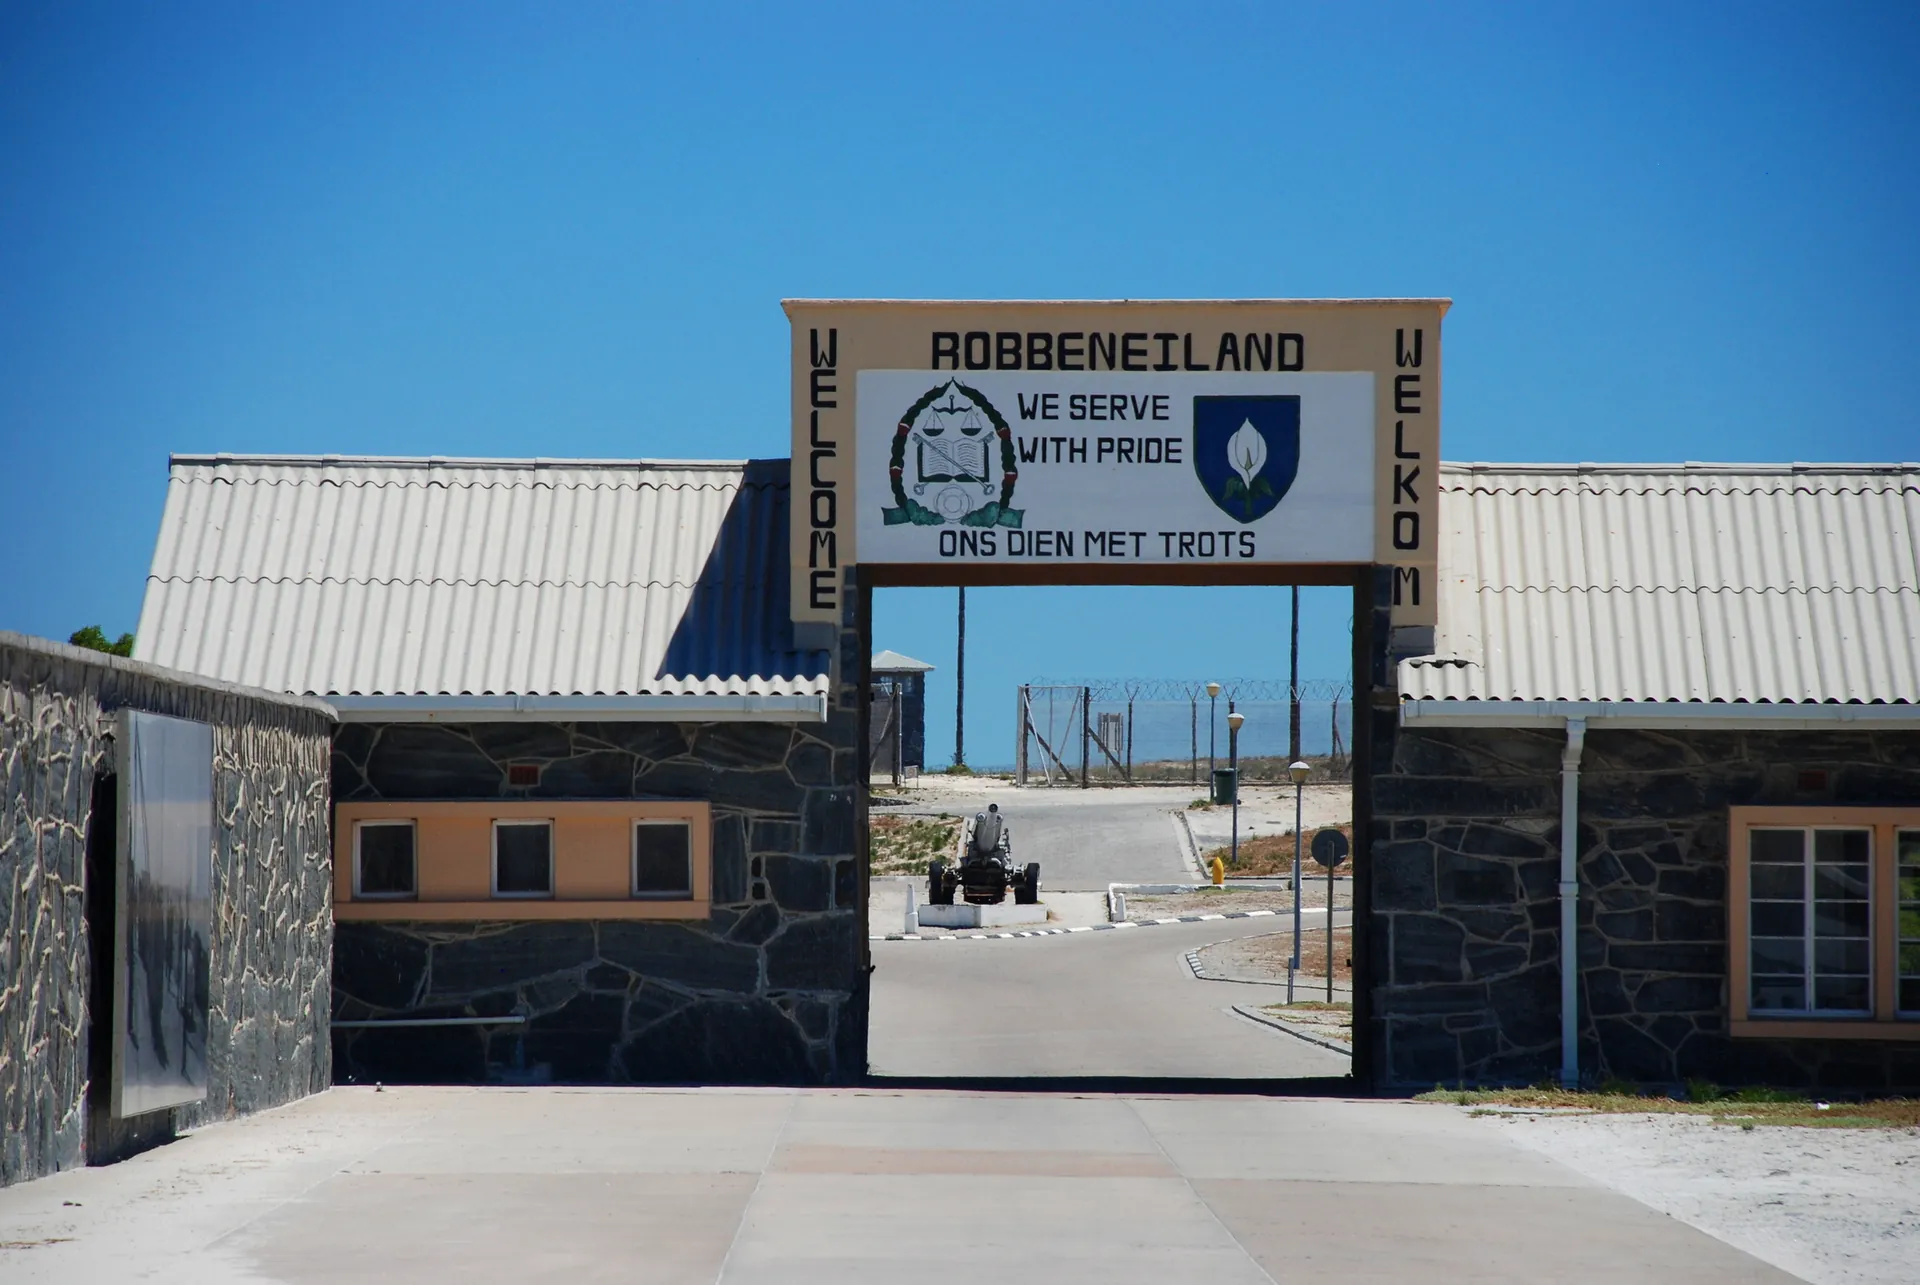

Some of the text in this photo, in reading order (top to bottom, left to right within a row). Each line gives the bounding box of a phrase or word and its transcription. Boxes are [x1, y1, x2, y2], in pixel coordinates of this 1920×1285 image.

[932, 331, 1304, 372] ROBBENEILAND
[1018, 393, 1169, 420] WE SERVE
[1018, 437, 1182, 463] WITH PRIDE
[1393, 328, 1423, 606] WELKOM
[809, 328, 837, 609] WELCOME
[940, 531, 1255, 557] ONS DIEN MET TROTS
